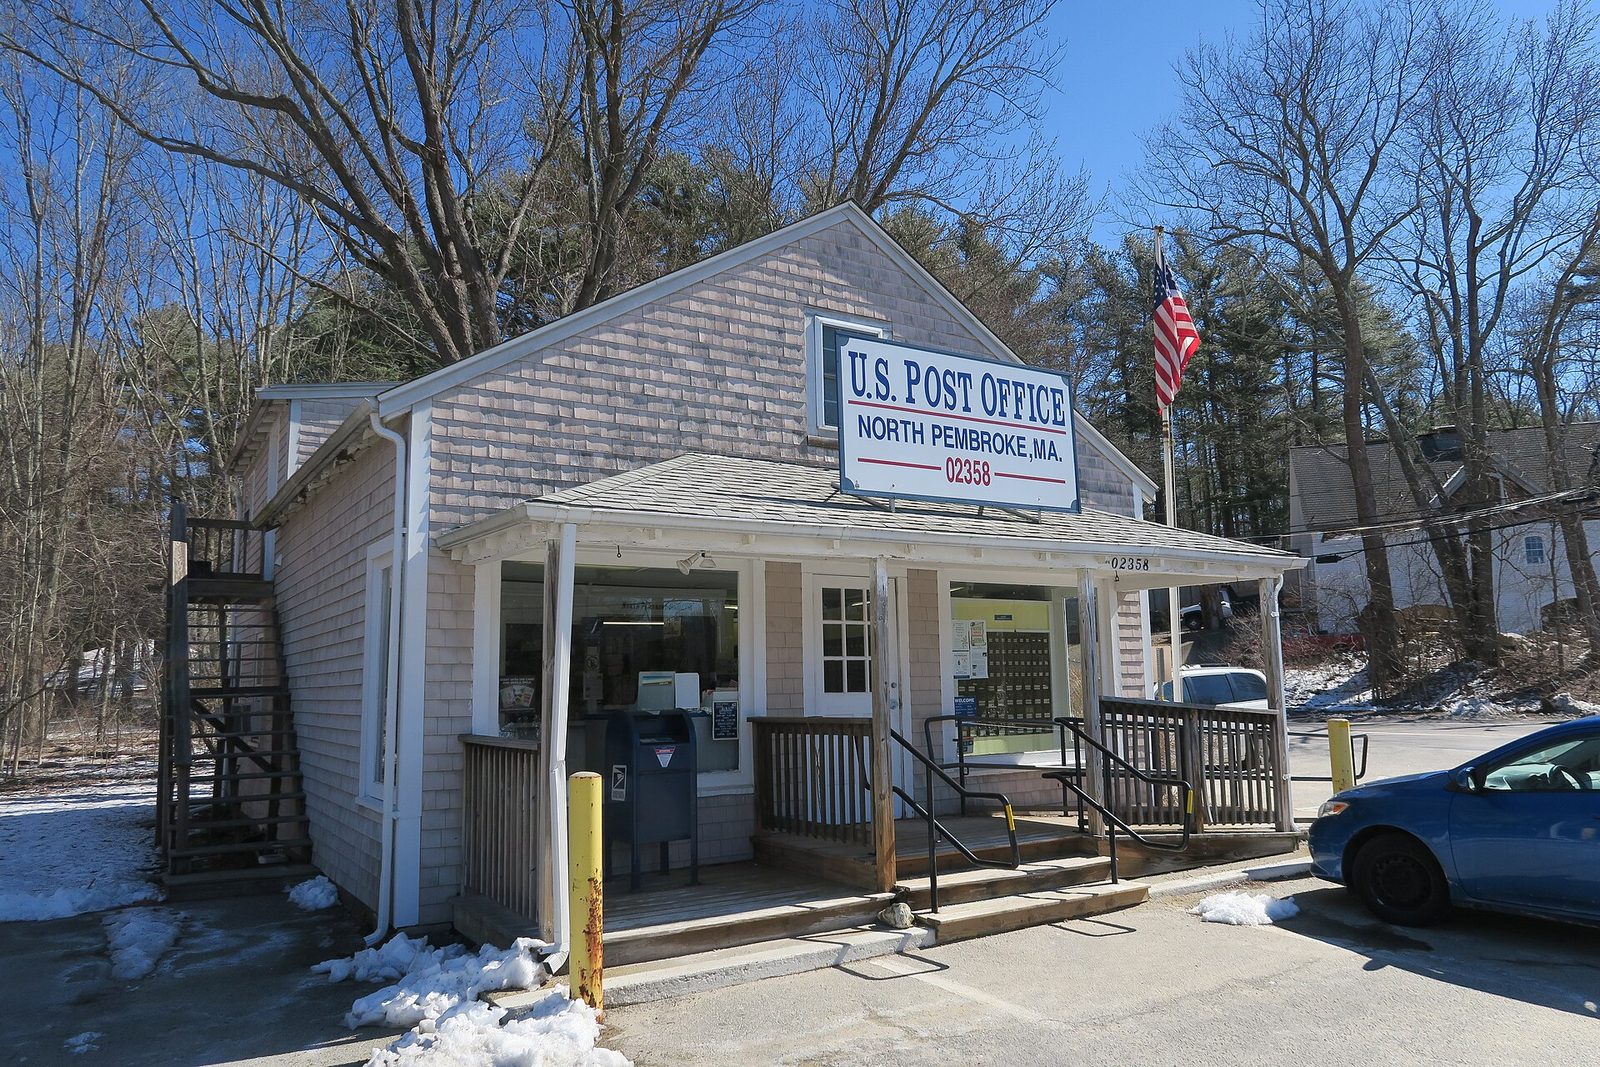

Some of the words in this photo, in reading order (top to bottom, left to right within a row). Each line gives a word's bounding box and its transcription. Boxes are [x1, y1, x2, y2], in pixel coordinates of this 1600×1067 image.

[848, 350, 897, 402] U.S.
[904, 359, 972, 413] POST
[981, 372, 1066, 427] OFFICE
[857, 414, 925, 445] NORTH
[945, 456, 991, 487] 02358
[1111, 557, 1149, 571] 02358
